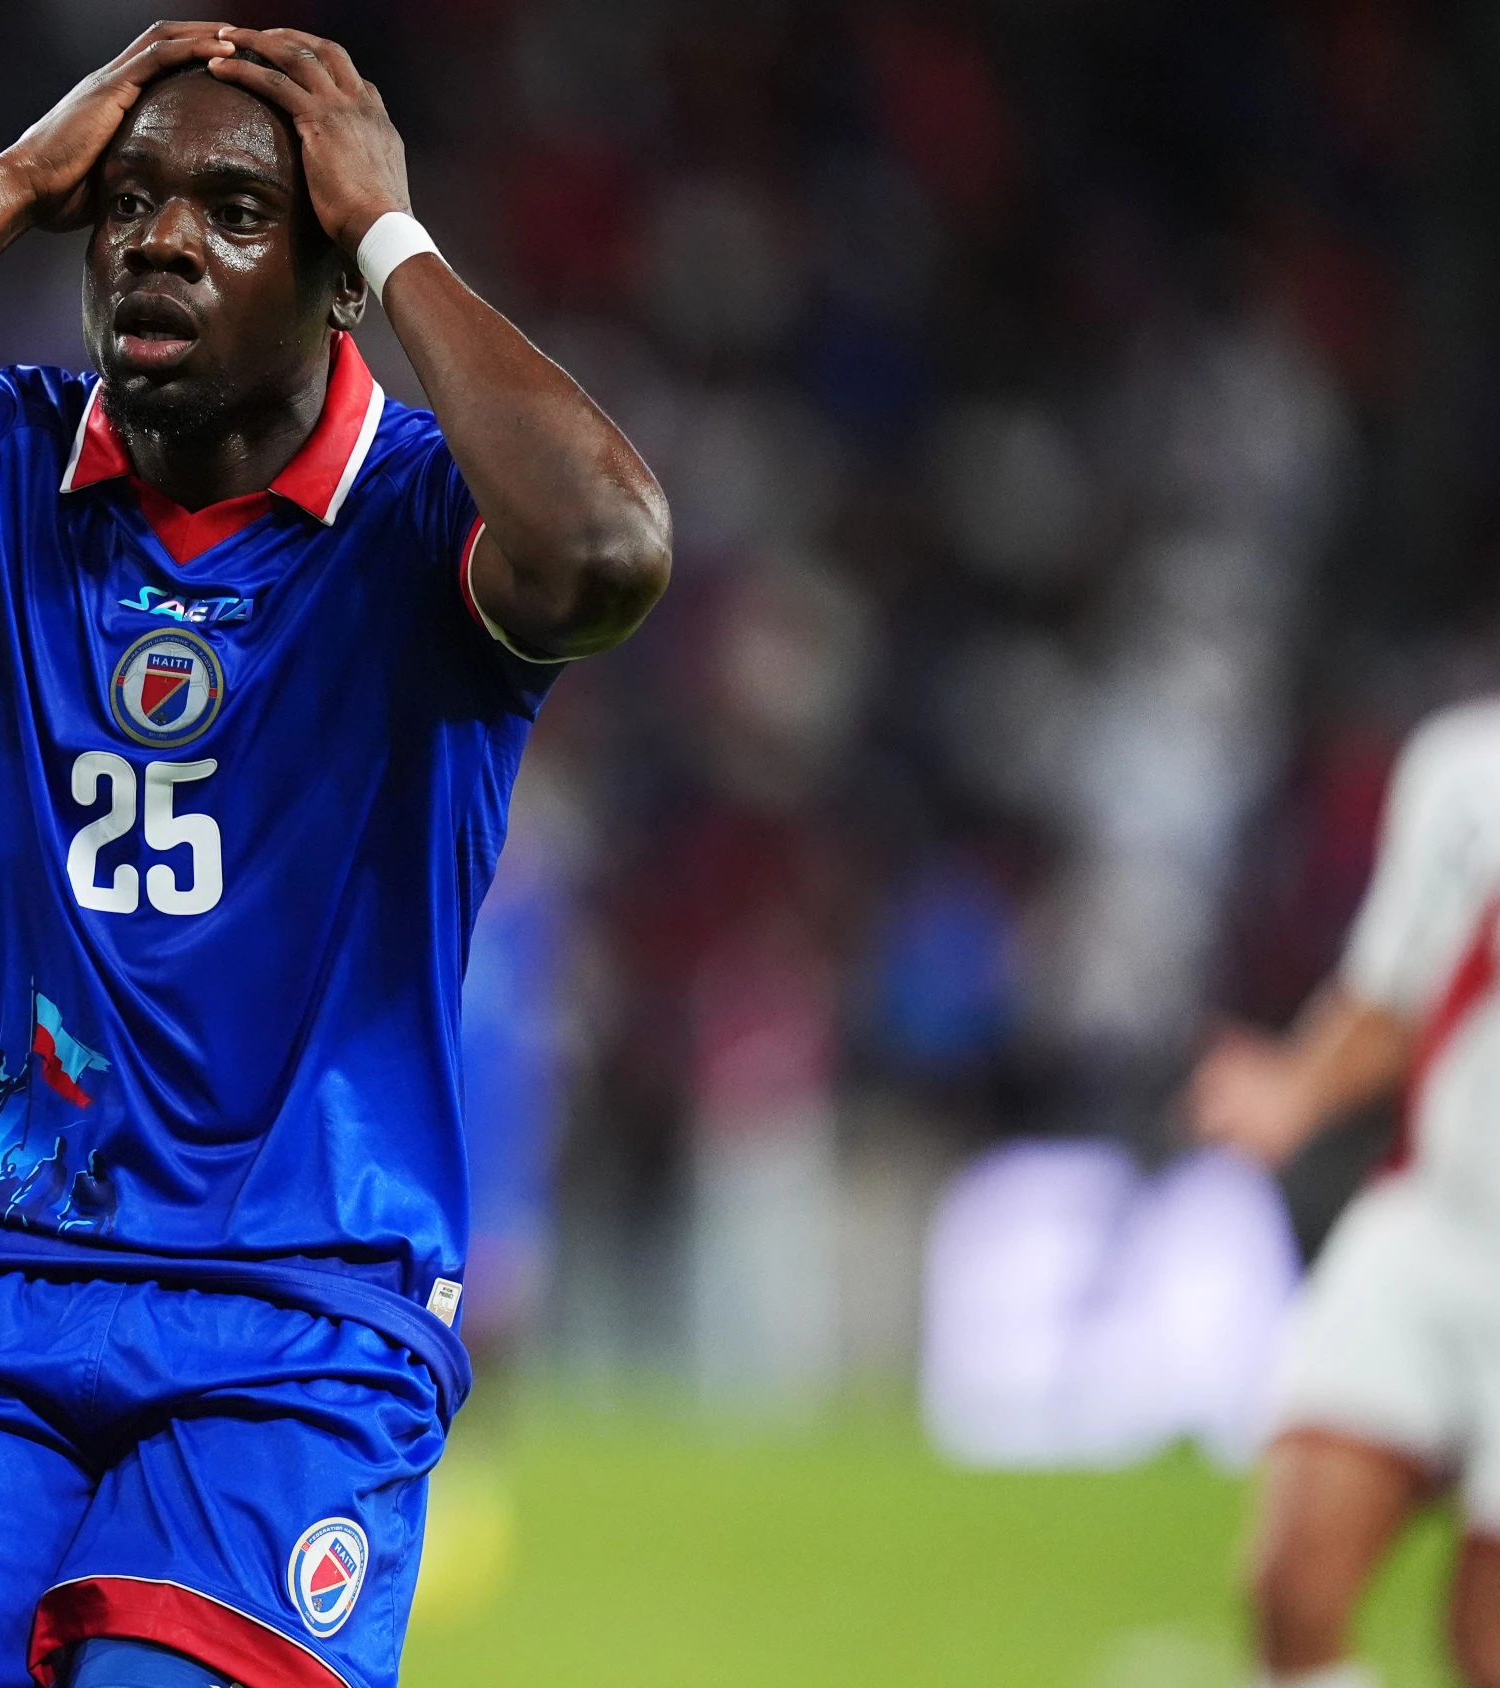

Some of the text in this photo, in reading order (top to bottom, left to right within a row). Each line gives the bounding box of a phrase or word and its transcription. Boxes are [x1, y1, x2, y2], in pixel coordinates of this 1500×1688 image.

[118, 586, 254, 622] SAETA
[152, 656, 188, 669] HAITI
[67, 751, 223, 915] 25
[334, 1542, 355, 1572] HAITI
